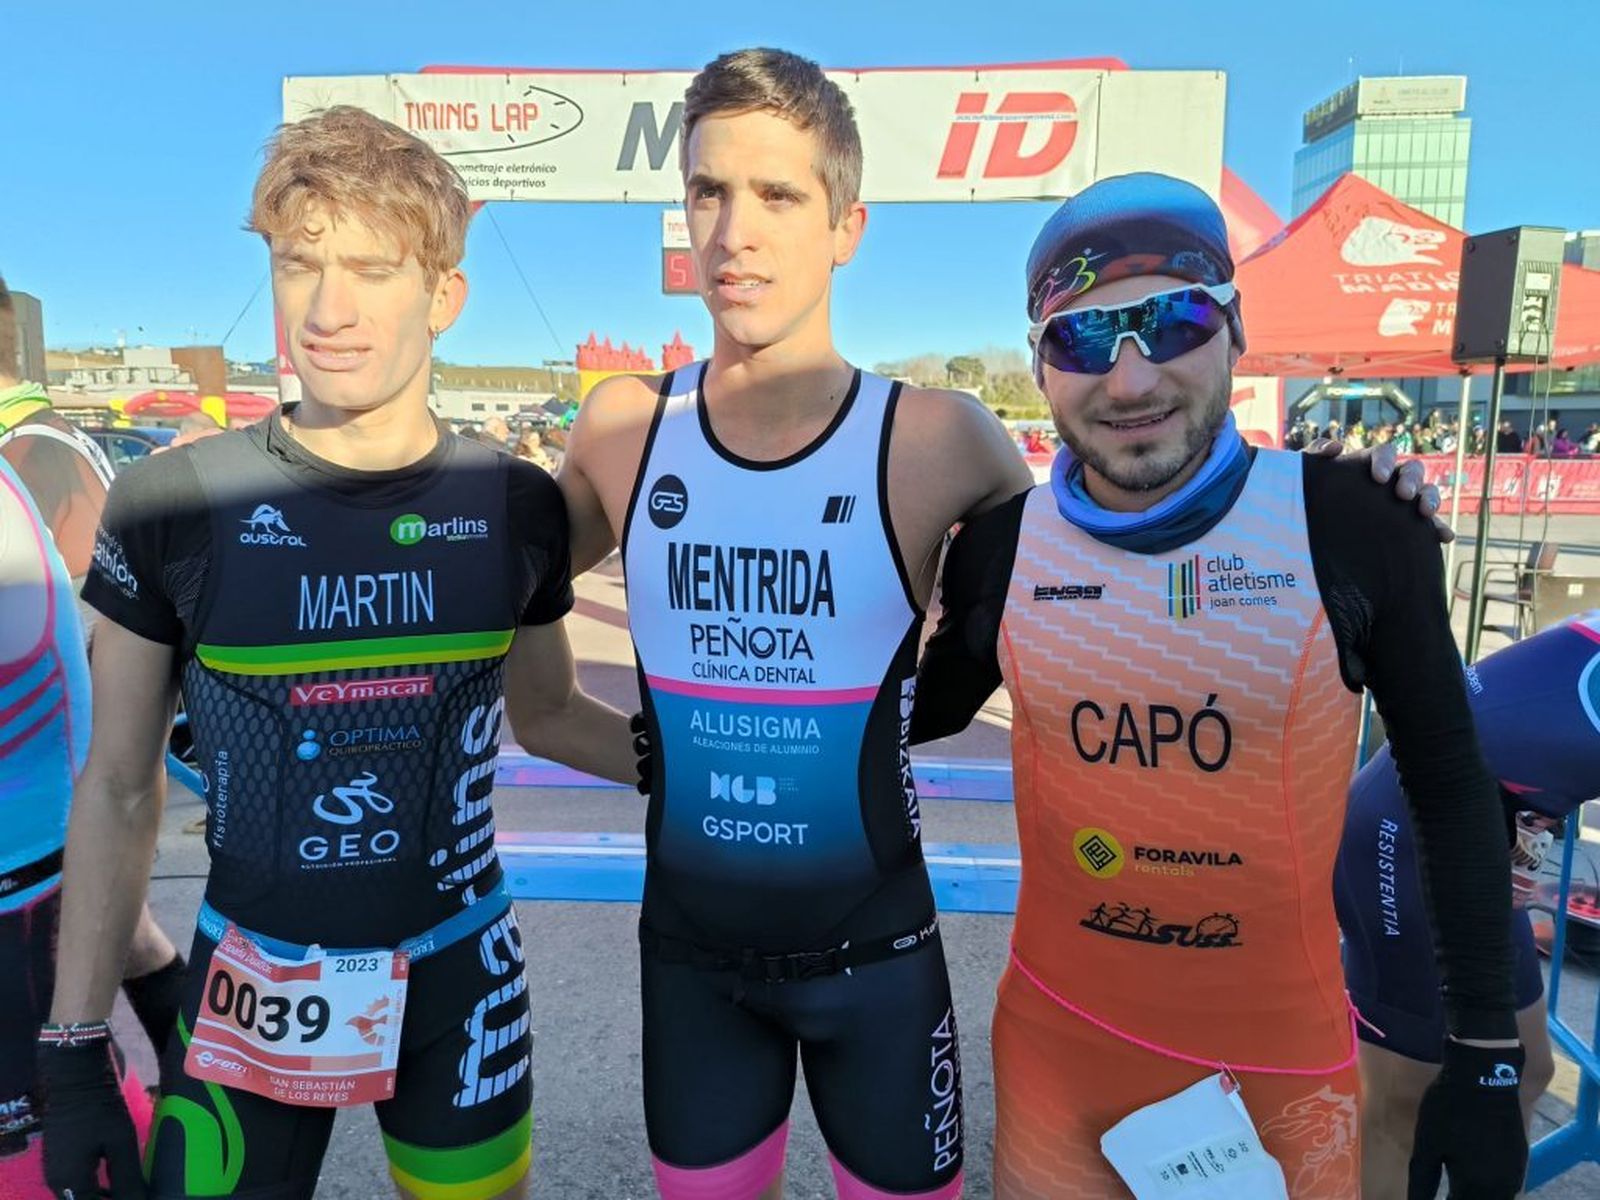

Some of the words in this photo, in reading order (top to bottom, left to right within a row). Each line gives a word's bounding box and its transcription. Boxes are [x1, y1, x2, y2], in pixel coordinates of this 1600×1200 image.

[405, 102, 479, 131] TIMING
[491, 103, 538, 132] LAP
[616, 101, 685, 171] M
[493, 177, 546, 189] deportivos
[398, 516, 488, 540] marlins
[1207, 553, 1245, 573] club
[667, 541, 836, 618] MENTRIDA
[1207, 570, 1296, 593] atletisme
[298, 569, 435, 631] MARTIN
[1210, 598, 1237, 611] joan
[1240, 595, 1278, 607] comes
[691, 616, 814, 661] PEÑOTA
[691, 659, 751, 682] CLÍNICA
[754, 666, 816, 684] DENTAL
[330, 725, 420, 746] OPTIMA
[690, 709, 821, 739] ALUSIGMA
[1071, 693, 1232, 773] CAPÓ
[702, 815, 809, 845] GSPORT
[299, 830, 400, 861] GEO
[1133, 847, 1243, 866] FORAVILA
[1378, 817, 1401, 937] RESISTENTIA
[334, 958, 379, 974] 2023
[207, 968, 331, 1045] 0039
[288, 1092, 311, 1101] LOS
[313, 1092, 349, 1102] REYES
[292, 1079, 356, 1091] SEBASTIÁN
[924, 1005, 959, 1171] PEÑOTA
